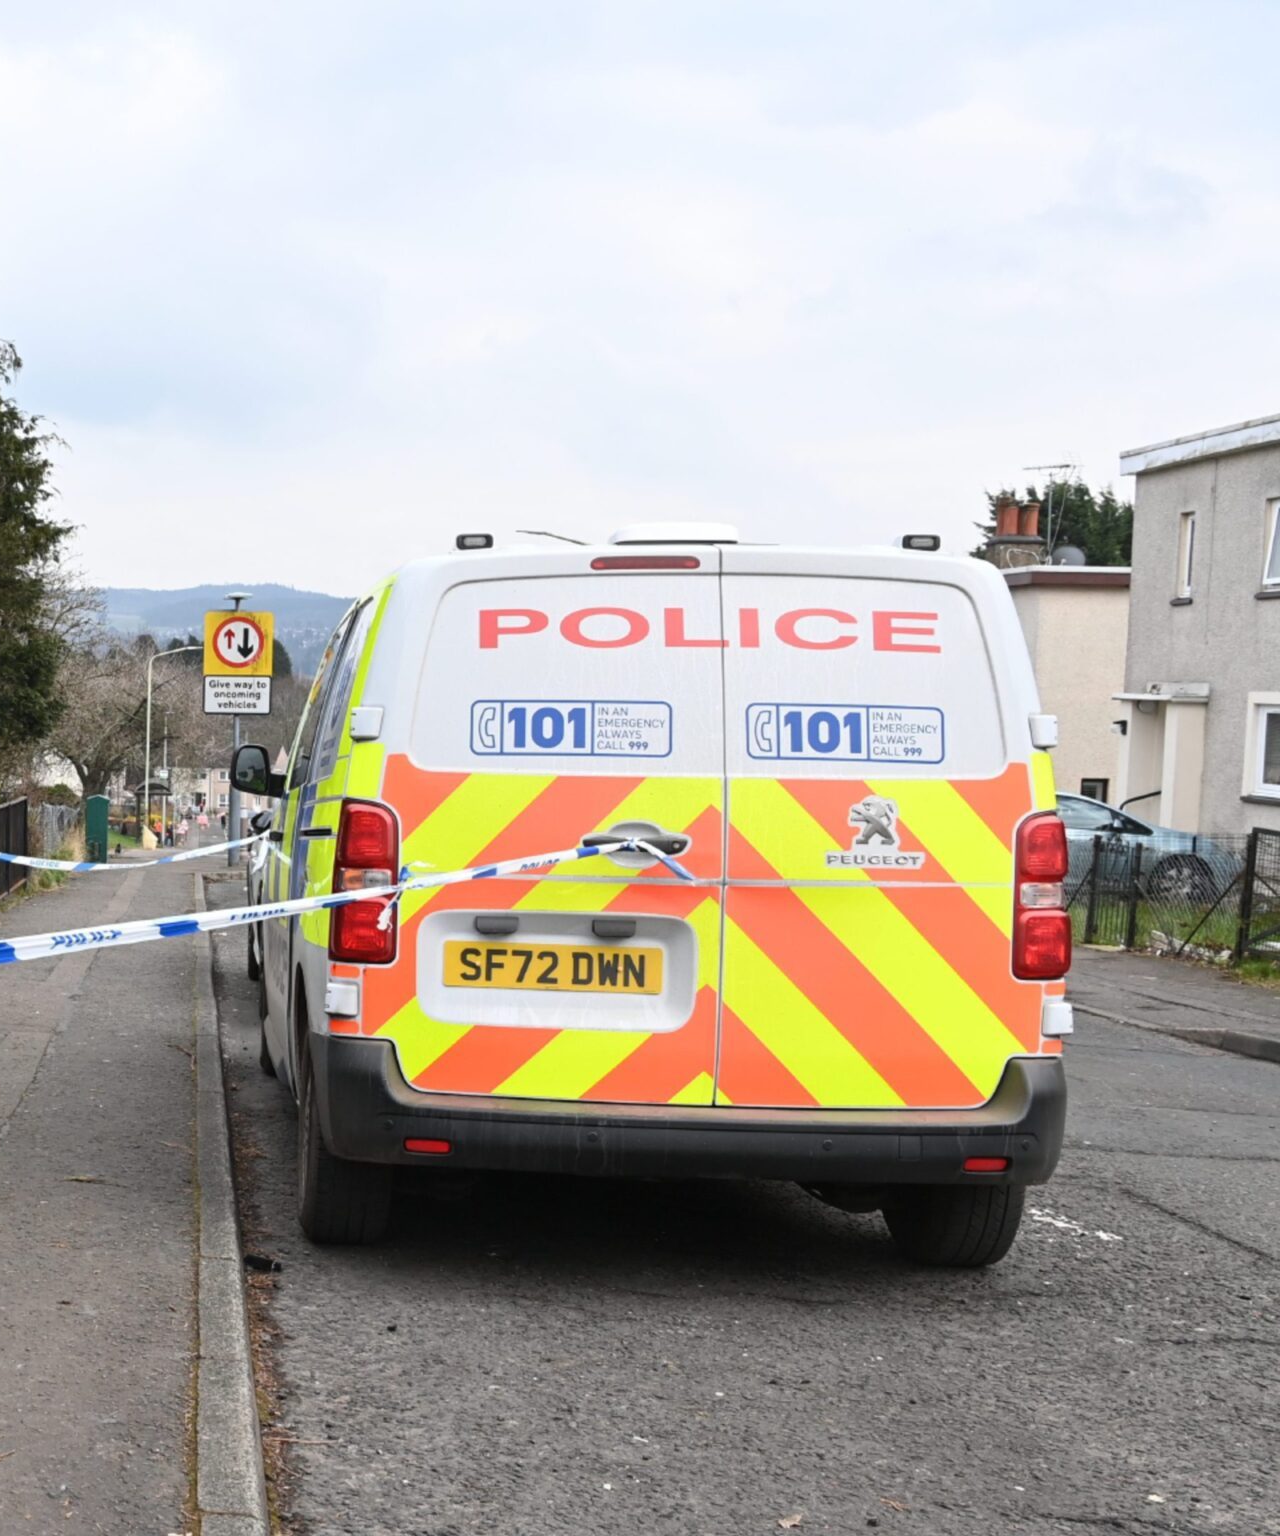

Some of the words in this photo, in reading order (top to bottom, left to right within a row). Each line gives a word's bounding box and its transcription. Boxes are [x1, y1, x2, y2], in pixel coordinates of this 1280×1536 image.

[479, 607, 942, 653] POLICE
[208, 679, 231, 689] Give
[234, 682, 253, 690] way
[256, 681, 268, 689] to
[213, 691, 261, 701] oncoming
[217, 700, 258, 709] vehicles
[597, 707, 609, 716] IN
[612, 707, 629, 717] AN
[872, 712, 884, 721] IN
[886, 712, 903, 722] AN
[508, 707, 586, 749] 101
[597, 718, 666, 729] EMERGENCY
[872, 723, 939, 734] EMERGENCY
[596, 729, 642, 739] ALWAYS
[783, 711, 863, 754] 101
[596, 740, 626, 750] CALL
[627, 741, 649, 751] 999
[872, 735, 917, 745] ALWAYS
[872, 746, 902, 757] CALL
[903, 747, 923, 757] 999
[825, 854, 921, 866] PEUGEOT
[460, 947, 559, 984] SF72
[571, 951, 646, 987] DWN
